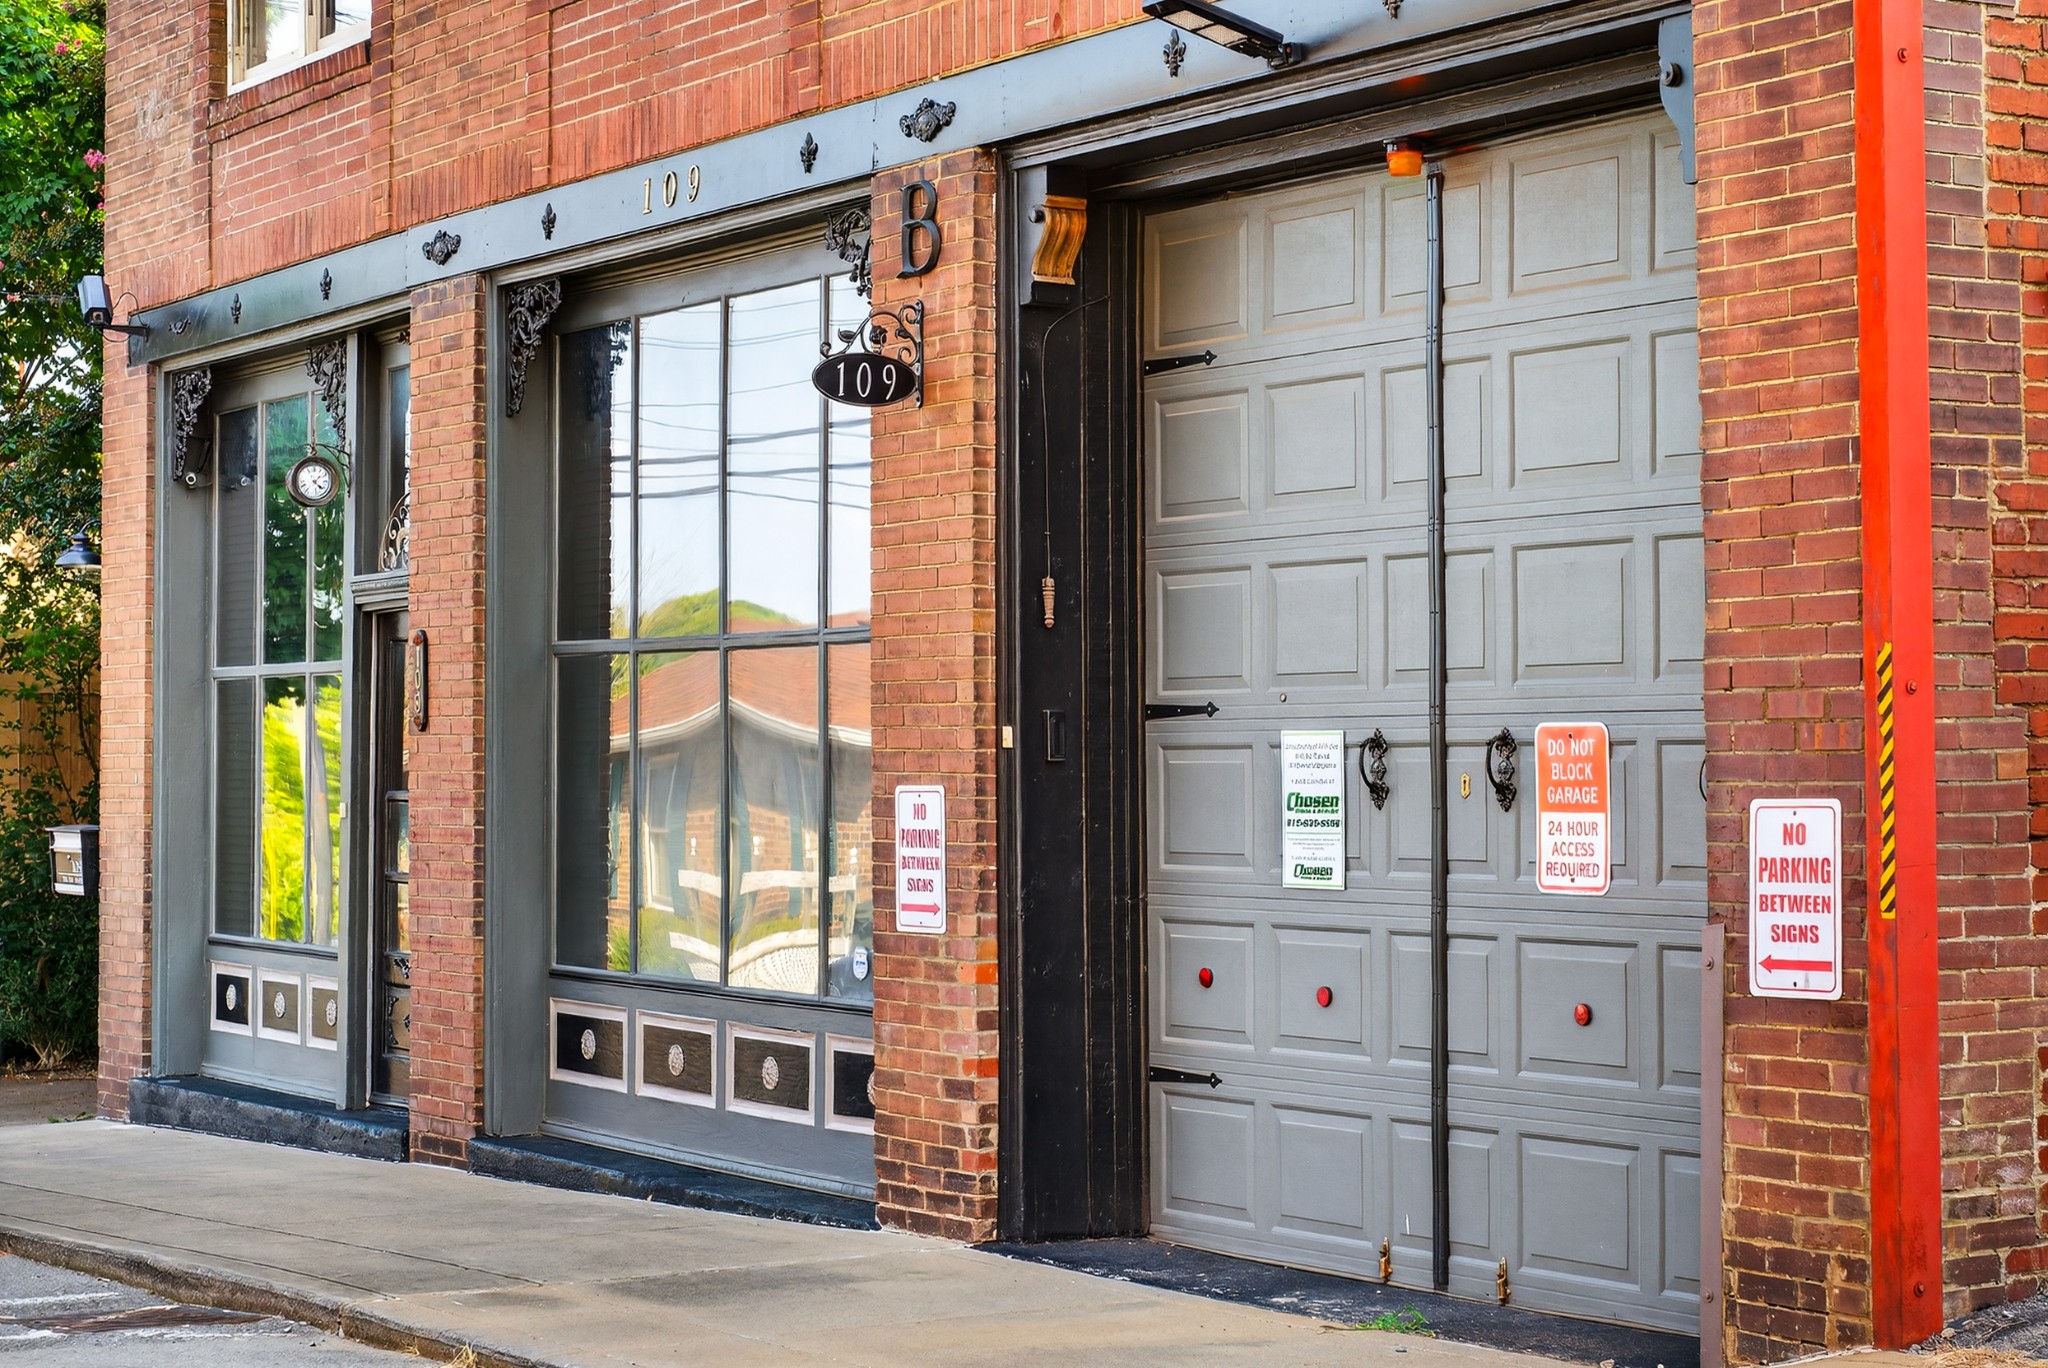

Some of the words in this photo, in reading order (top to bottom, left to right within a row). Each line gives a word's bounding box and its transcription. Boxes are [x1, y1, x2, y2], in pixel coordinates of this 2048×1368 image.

[642, 165, 700, 215] 109
[896, 179, 942, 279] B
[836, 361, 898, 401] 109
[1547, 739, 1565, 756] DO
[1570, 739, 1596, 756] NOT
[1551, 762, 1593, 780] BLOCK
[1286, 792, 1340, 811] Chosen
[1547, 786, 1599, 804] GARAGE
[913, 803, 927, 820] NO
[1548, 820, 1563, 836] 24
[1567, 821, 1599, 837] HOUR
[1782, 822, 1807, 846] NO
[1551, 842, 1595, 857] ACCESS
[1545, 861, 1600, 878] REQUIRED
[1758, 857, 1832, 884] PARKING
[1758, 894, 1832, 914] BETWEEN
[1770, 924, 1820, 944] SIGNS
